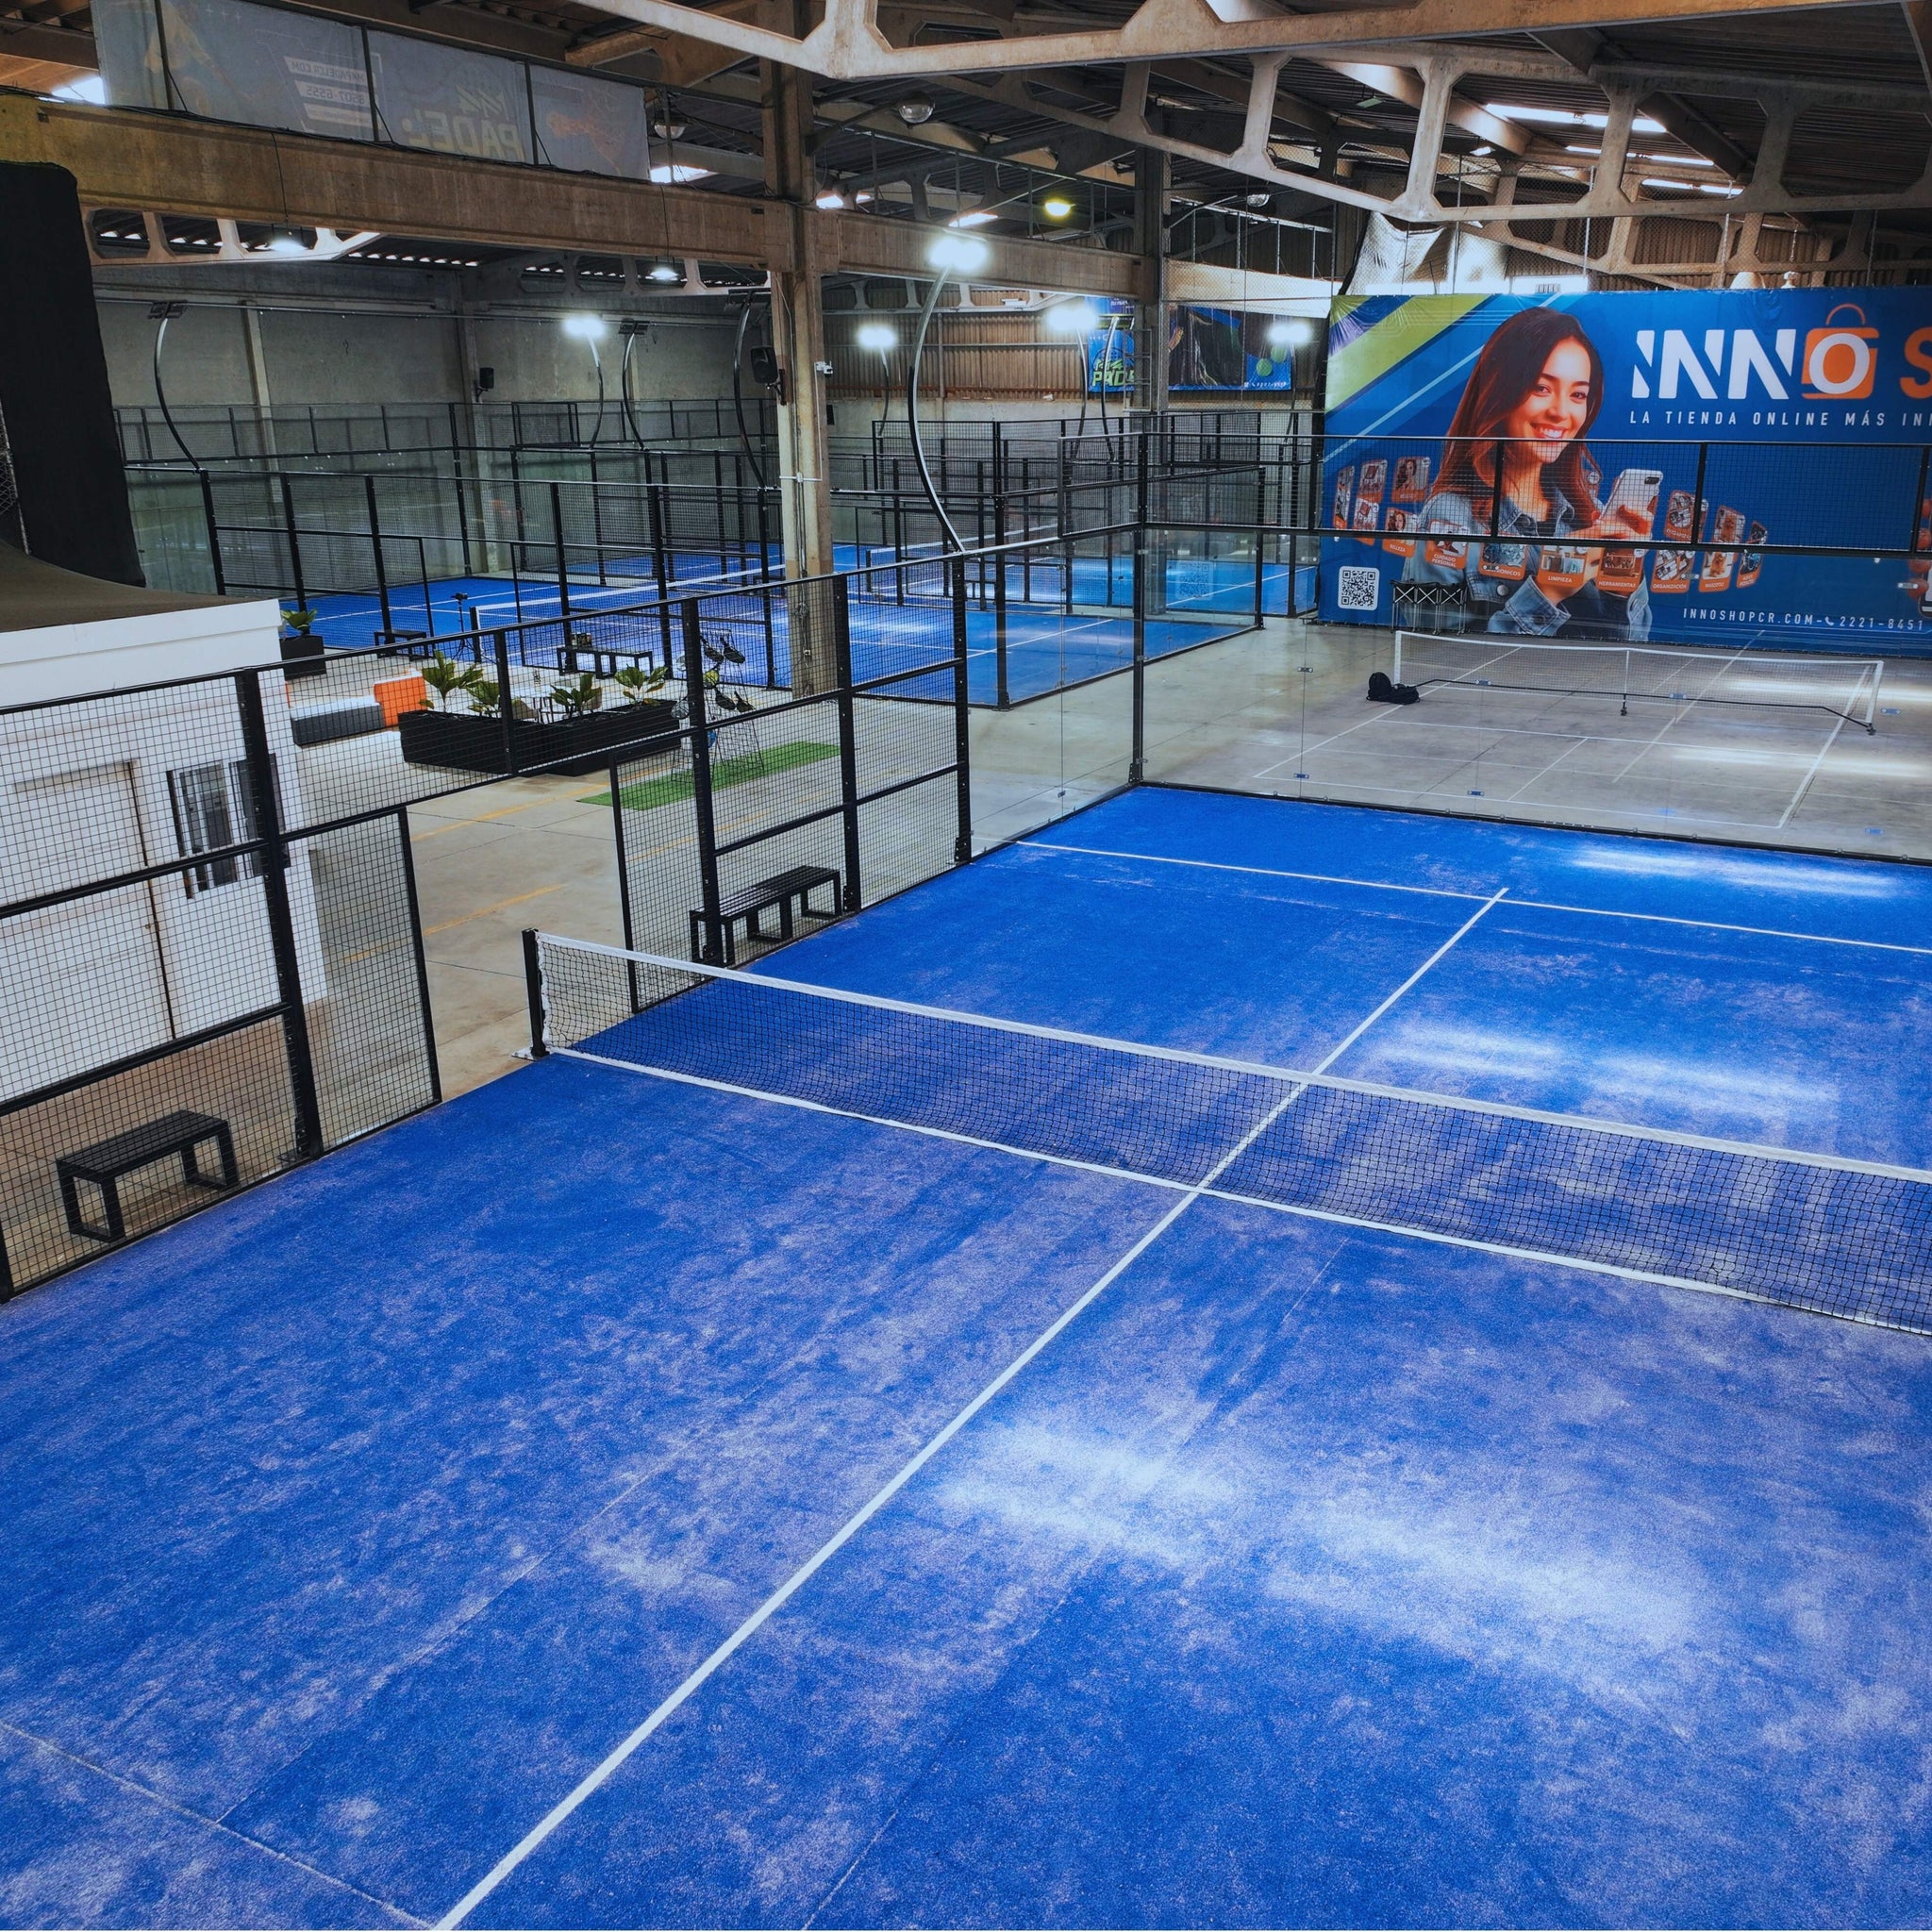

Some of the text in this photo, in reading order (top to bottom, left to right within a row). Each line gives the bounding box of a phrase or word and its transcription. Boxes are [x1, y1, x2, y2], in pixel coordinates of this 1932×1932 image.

[1632, 329, 1871, 400] INNO
[1630, 410, 1651, 425] LA
[1665, 411, 1738, 425] TIENDA
[1753, 412, 1830, 426] ONLINE
[1844, 409, 1886, 426] MÁS
[1839, 616, 1924, 630] 2221-8451
